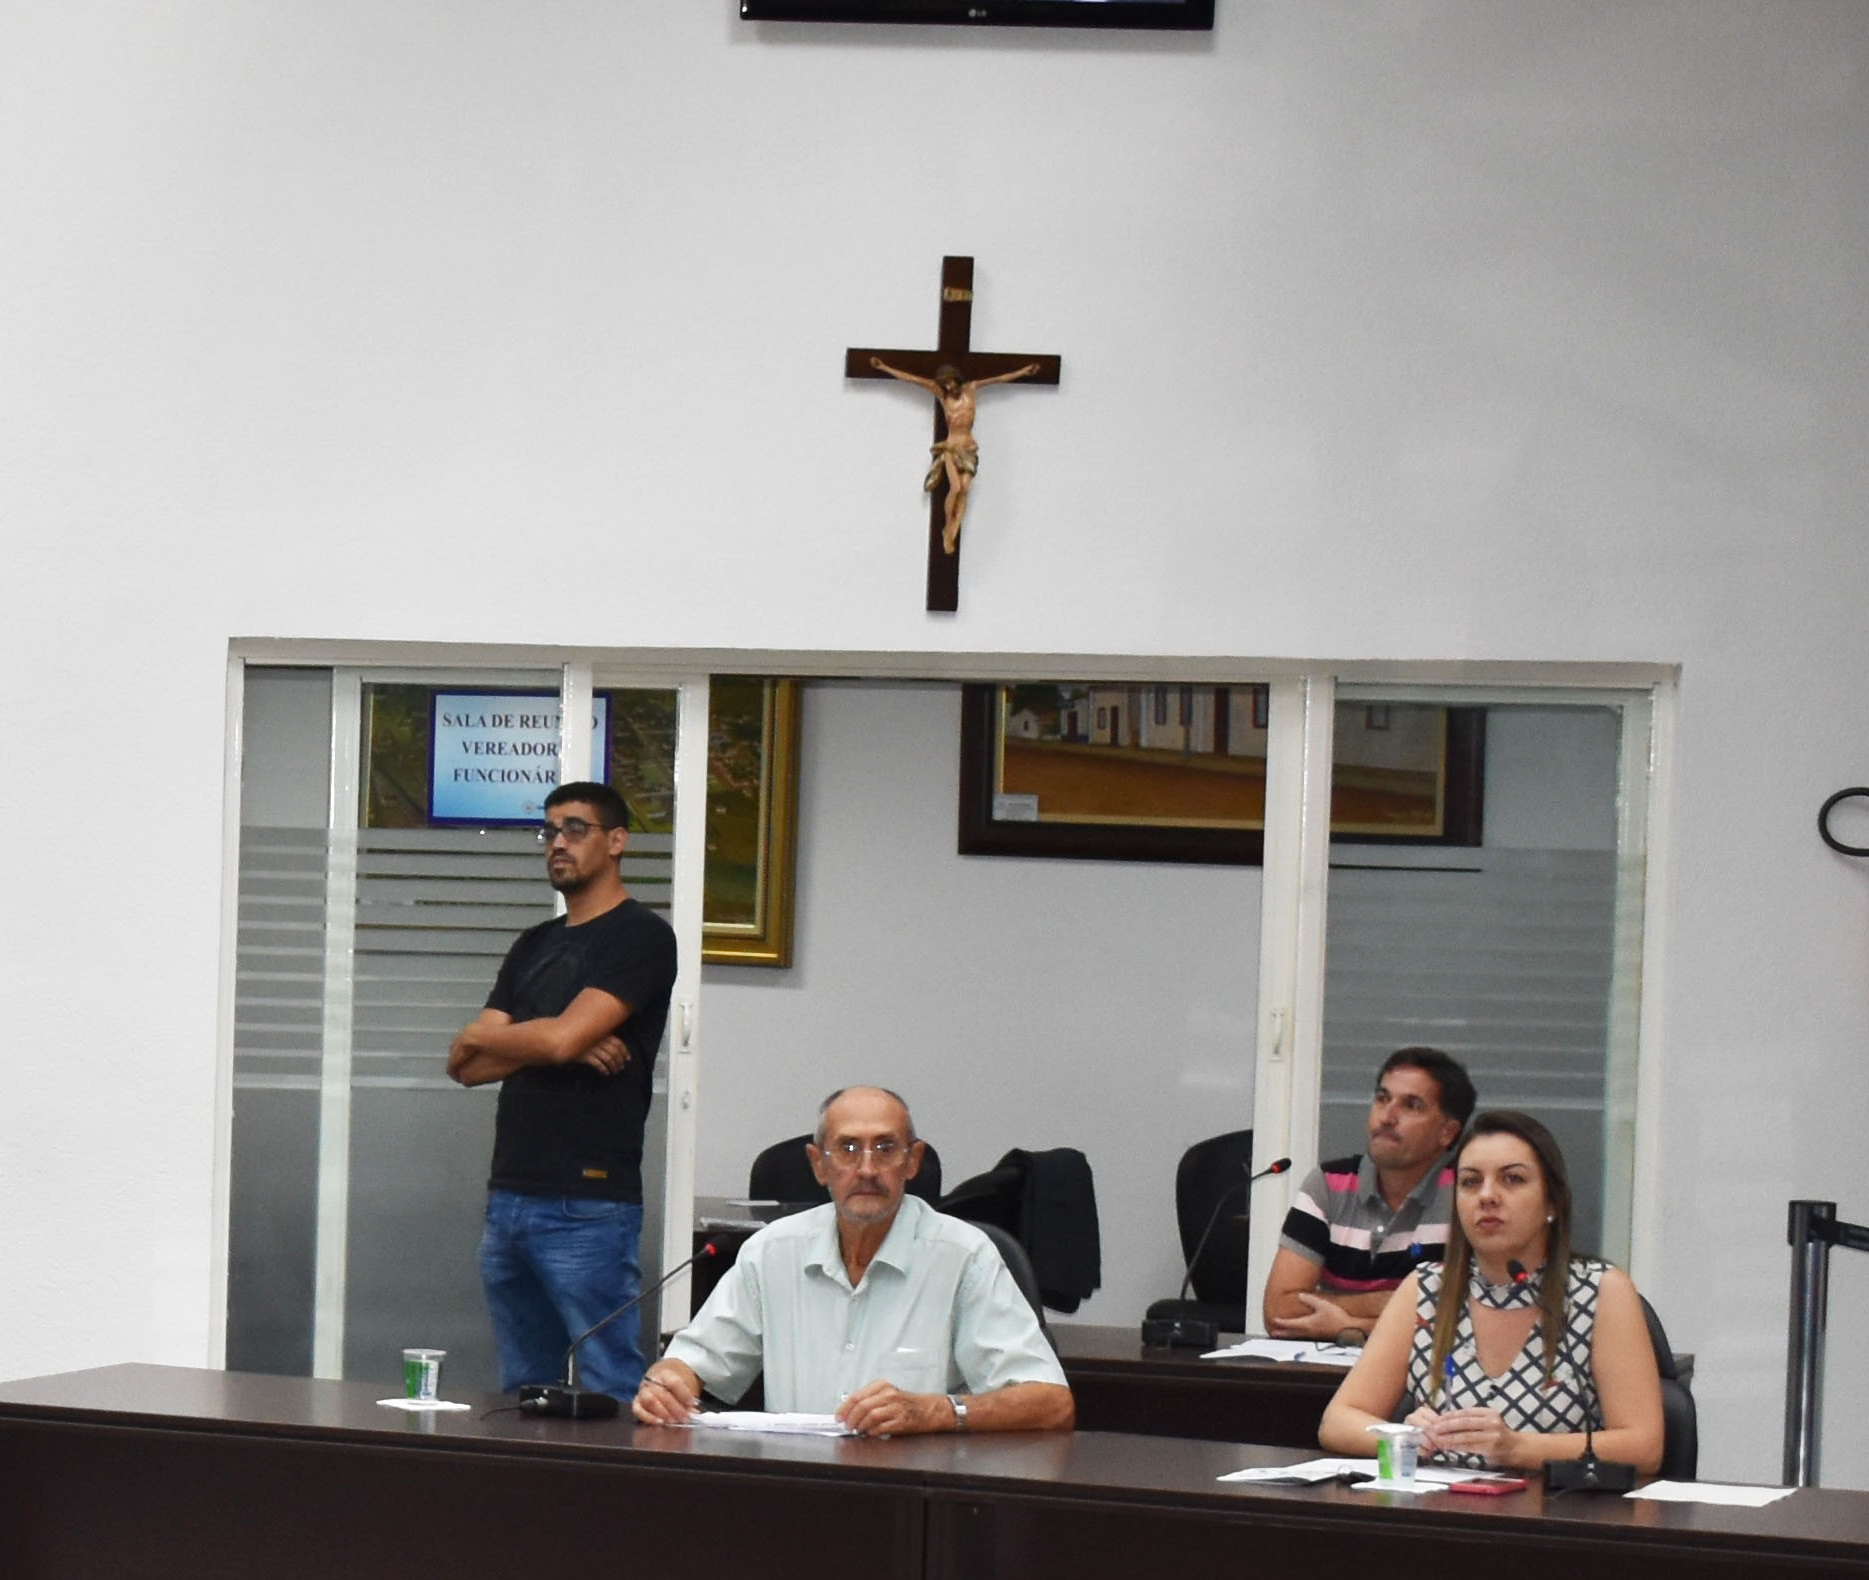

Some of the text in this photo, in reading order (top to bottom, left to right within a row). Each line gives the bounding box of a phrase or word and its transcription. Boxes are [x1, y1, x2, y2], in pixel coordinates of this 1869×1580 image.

[442, 711, 486, 729] SALA
[491, 713, 515, 729] DE
[461, 740, 559, 757] VEREADOR
[453, 765, 556, 784] FUNCIONÁR
